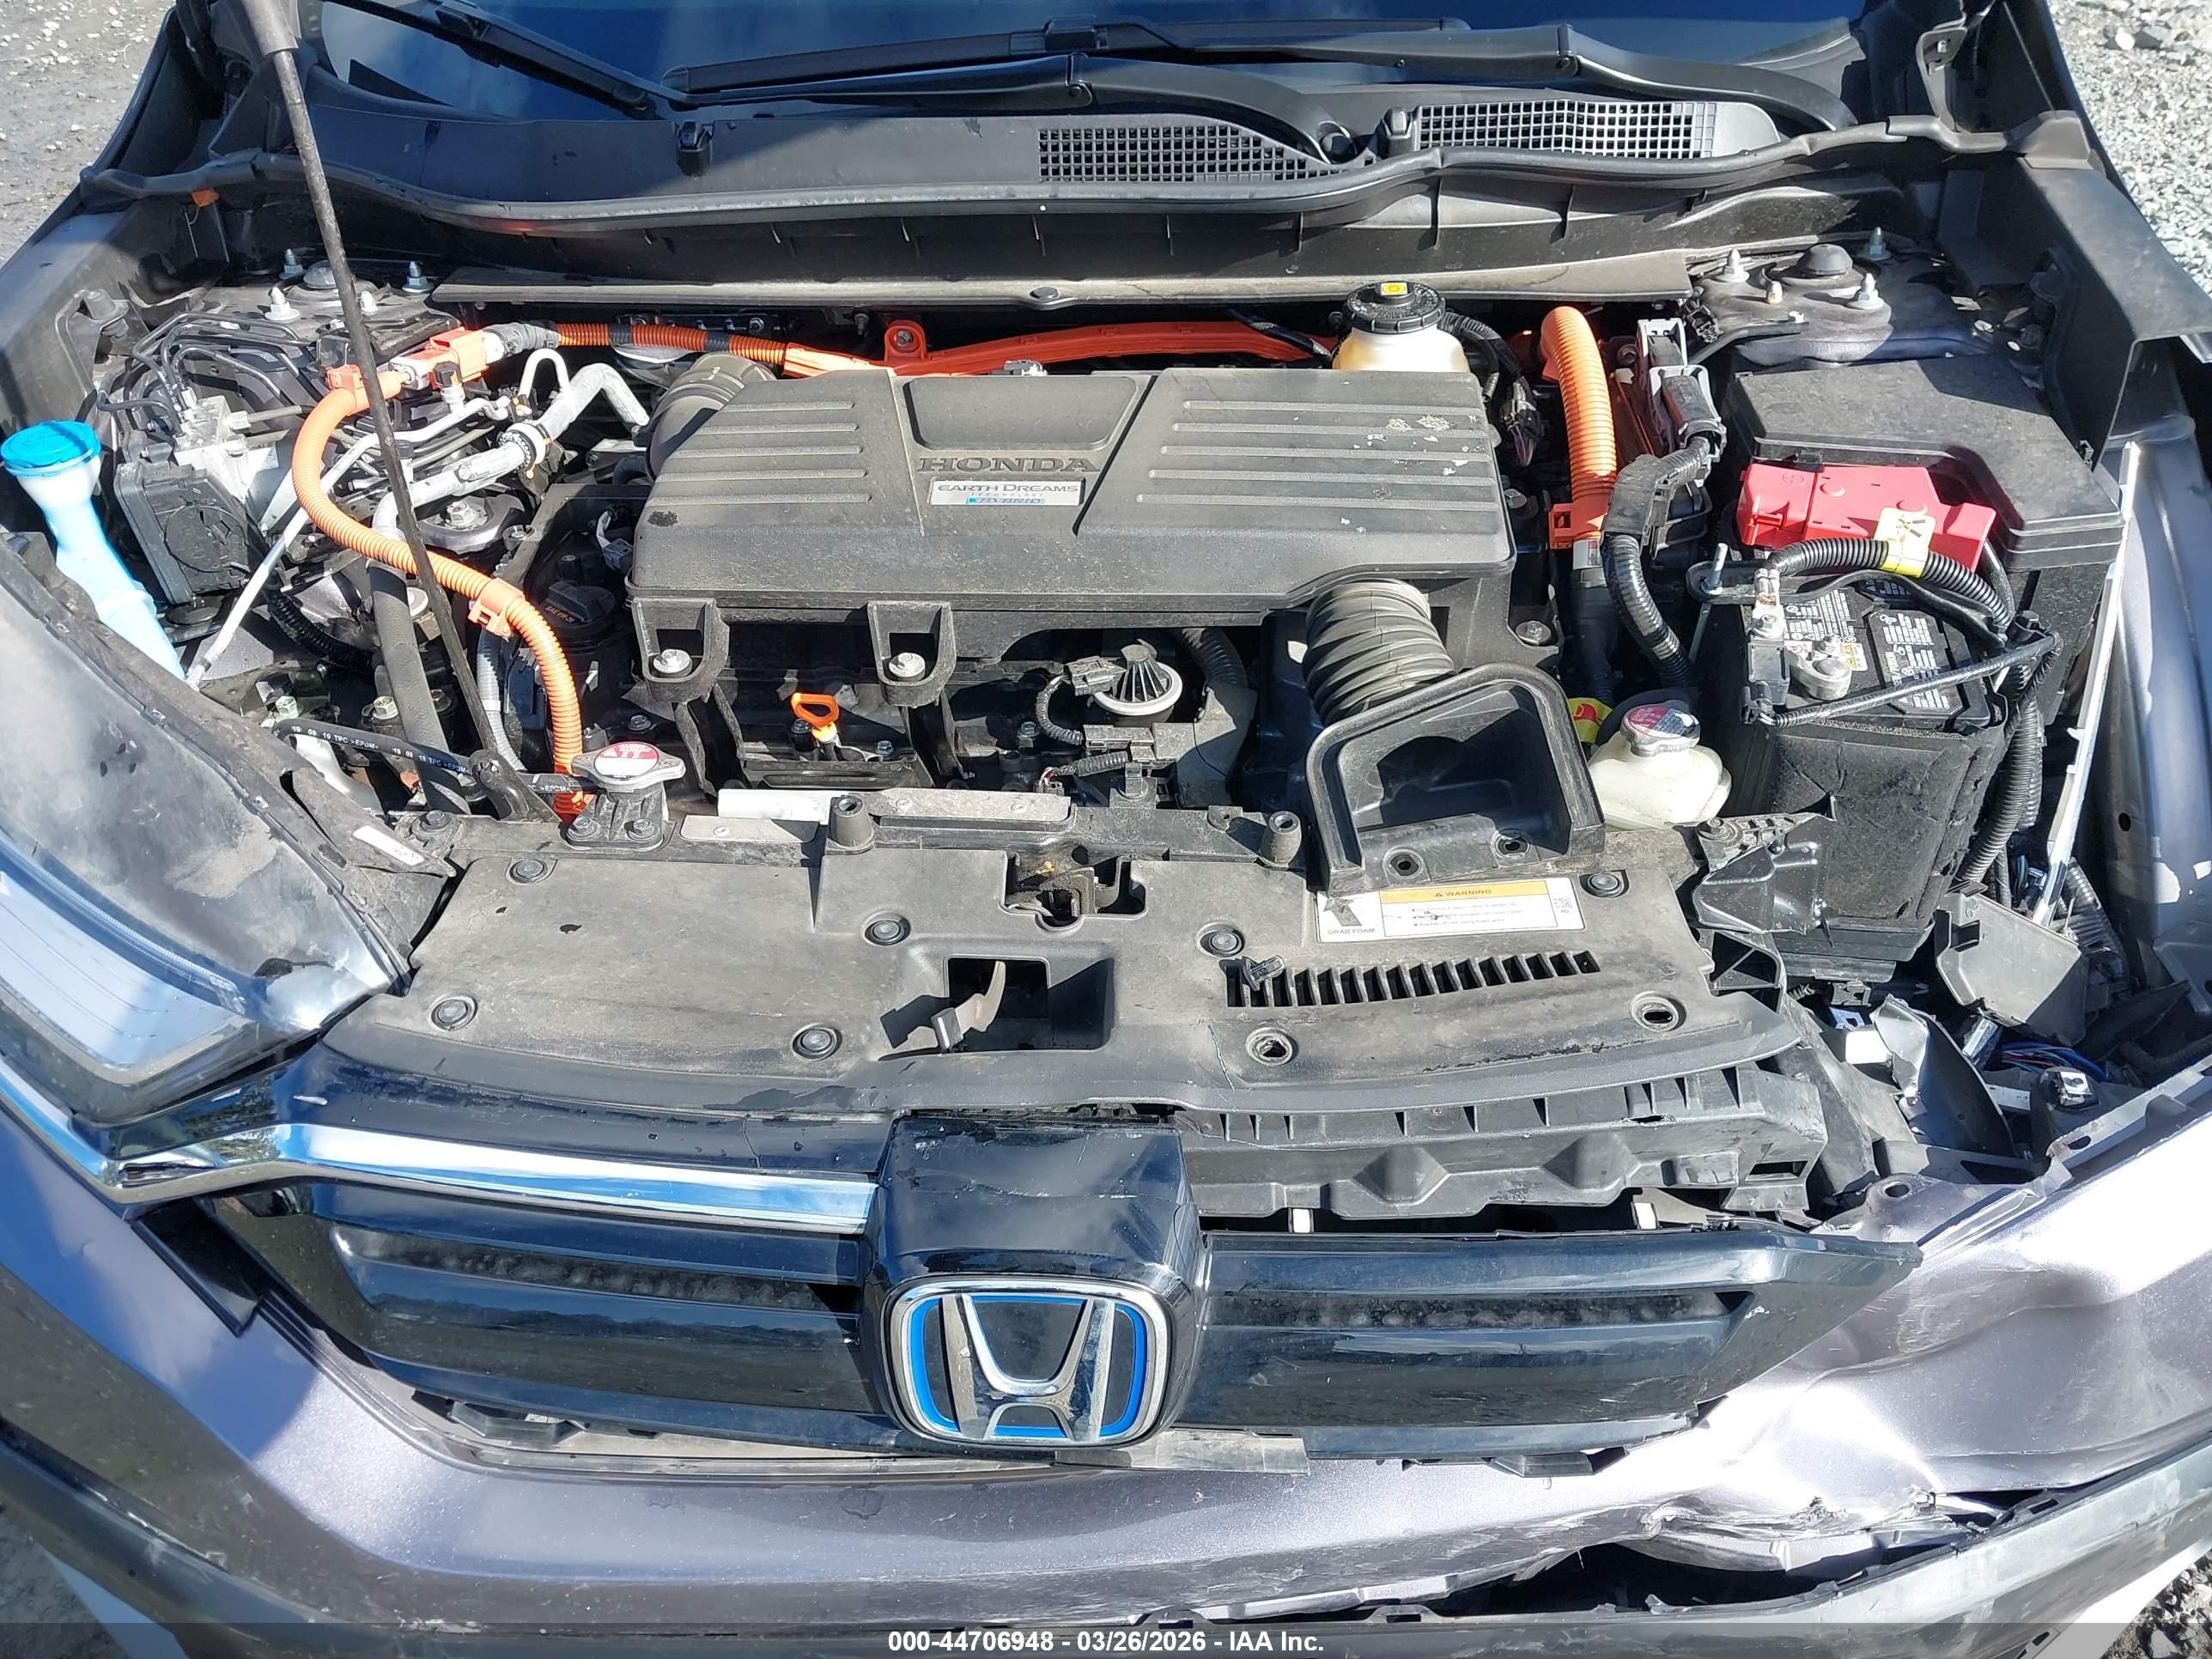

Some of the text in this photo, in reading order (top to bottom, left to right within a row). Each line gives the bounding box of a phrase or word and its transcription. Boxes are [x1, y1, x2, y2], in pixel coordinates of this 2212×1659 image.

[916, 457, 1101, 472] HONDA
[1002, 483, 1079, 493] DREAMS
[333, 734, 349, 744] TPC
[1445, 889, 1492, 897] WARNING
